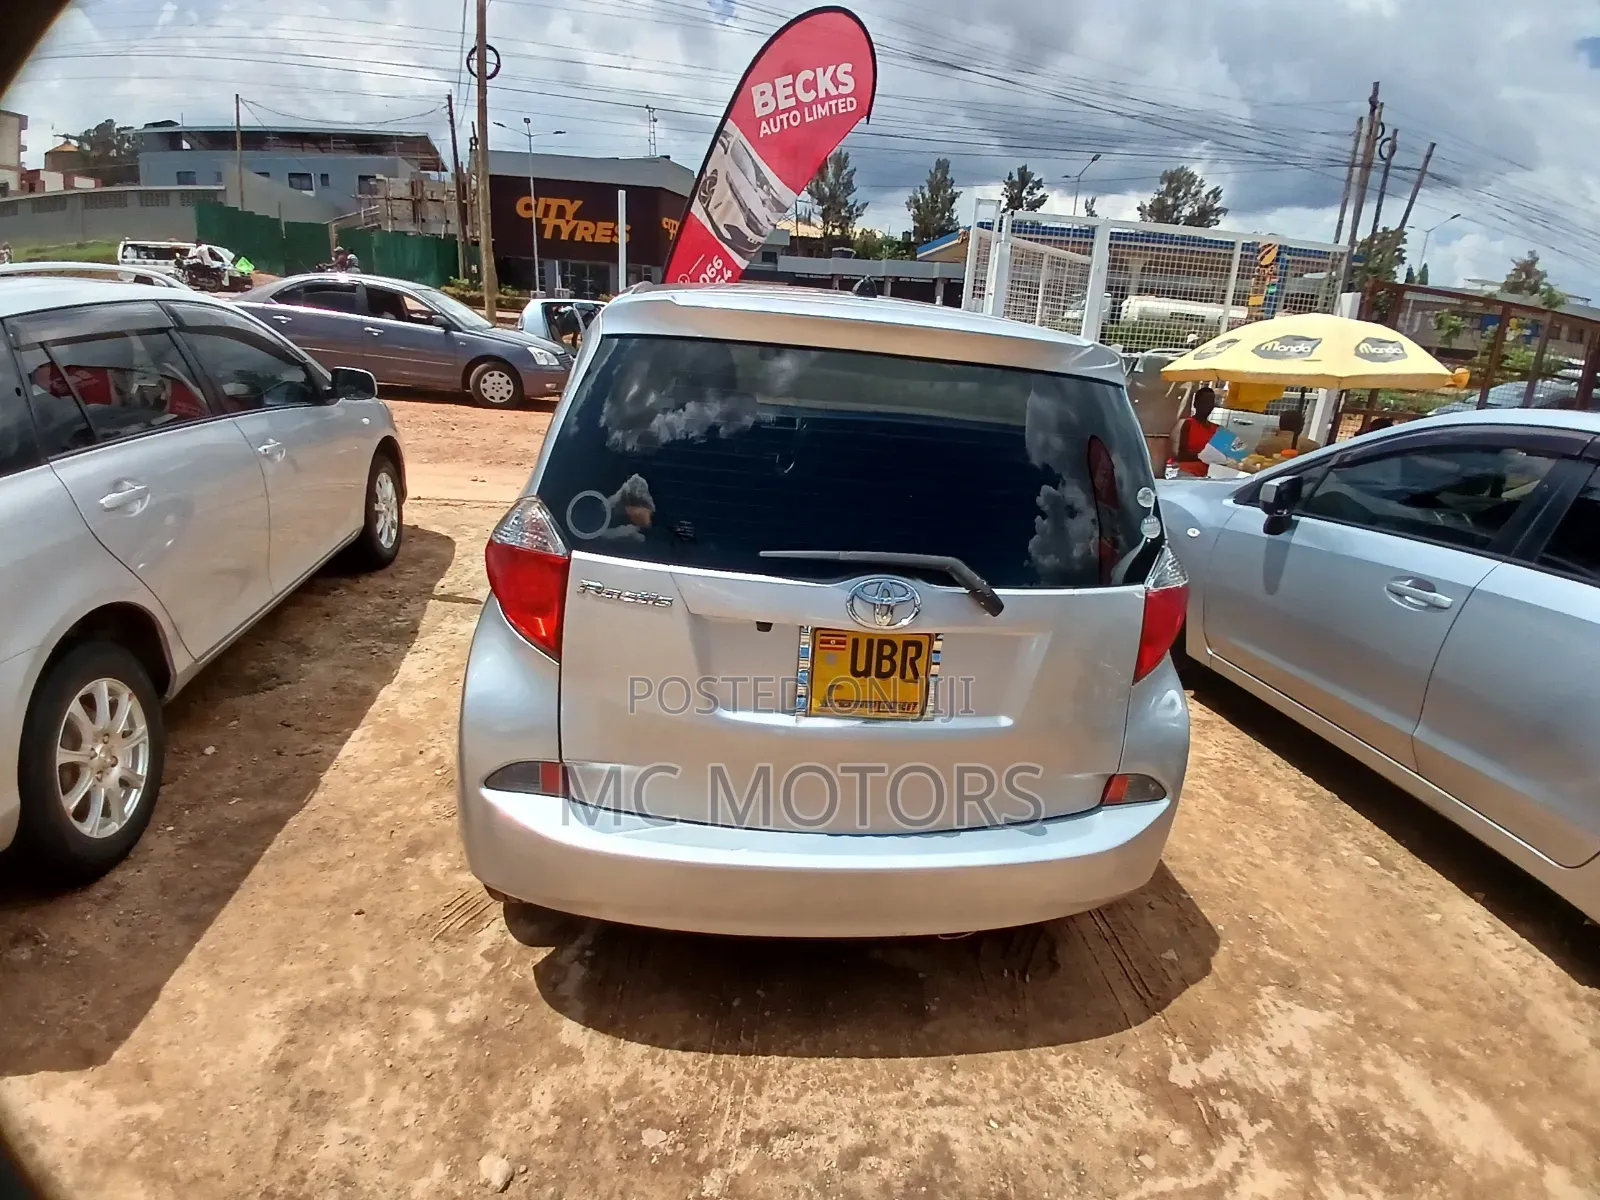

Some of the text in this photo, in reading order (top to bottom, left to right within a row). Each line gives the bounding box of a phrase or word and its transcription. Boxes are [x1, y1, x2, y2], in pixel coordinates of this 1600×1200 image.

[751, 62, 856, 118] BECKS
[759, 97, 857, 138] AUTO LIMTED
[516, 196, 583, 220] CITY
[542, 218, 631, 244] TYRES
[850, 637, 923, 680] UBR
